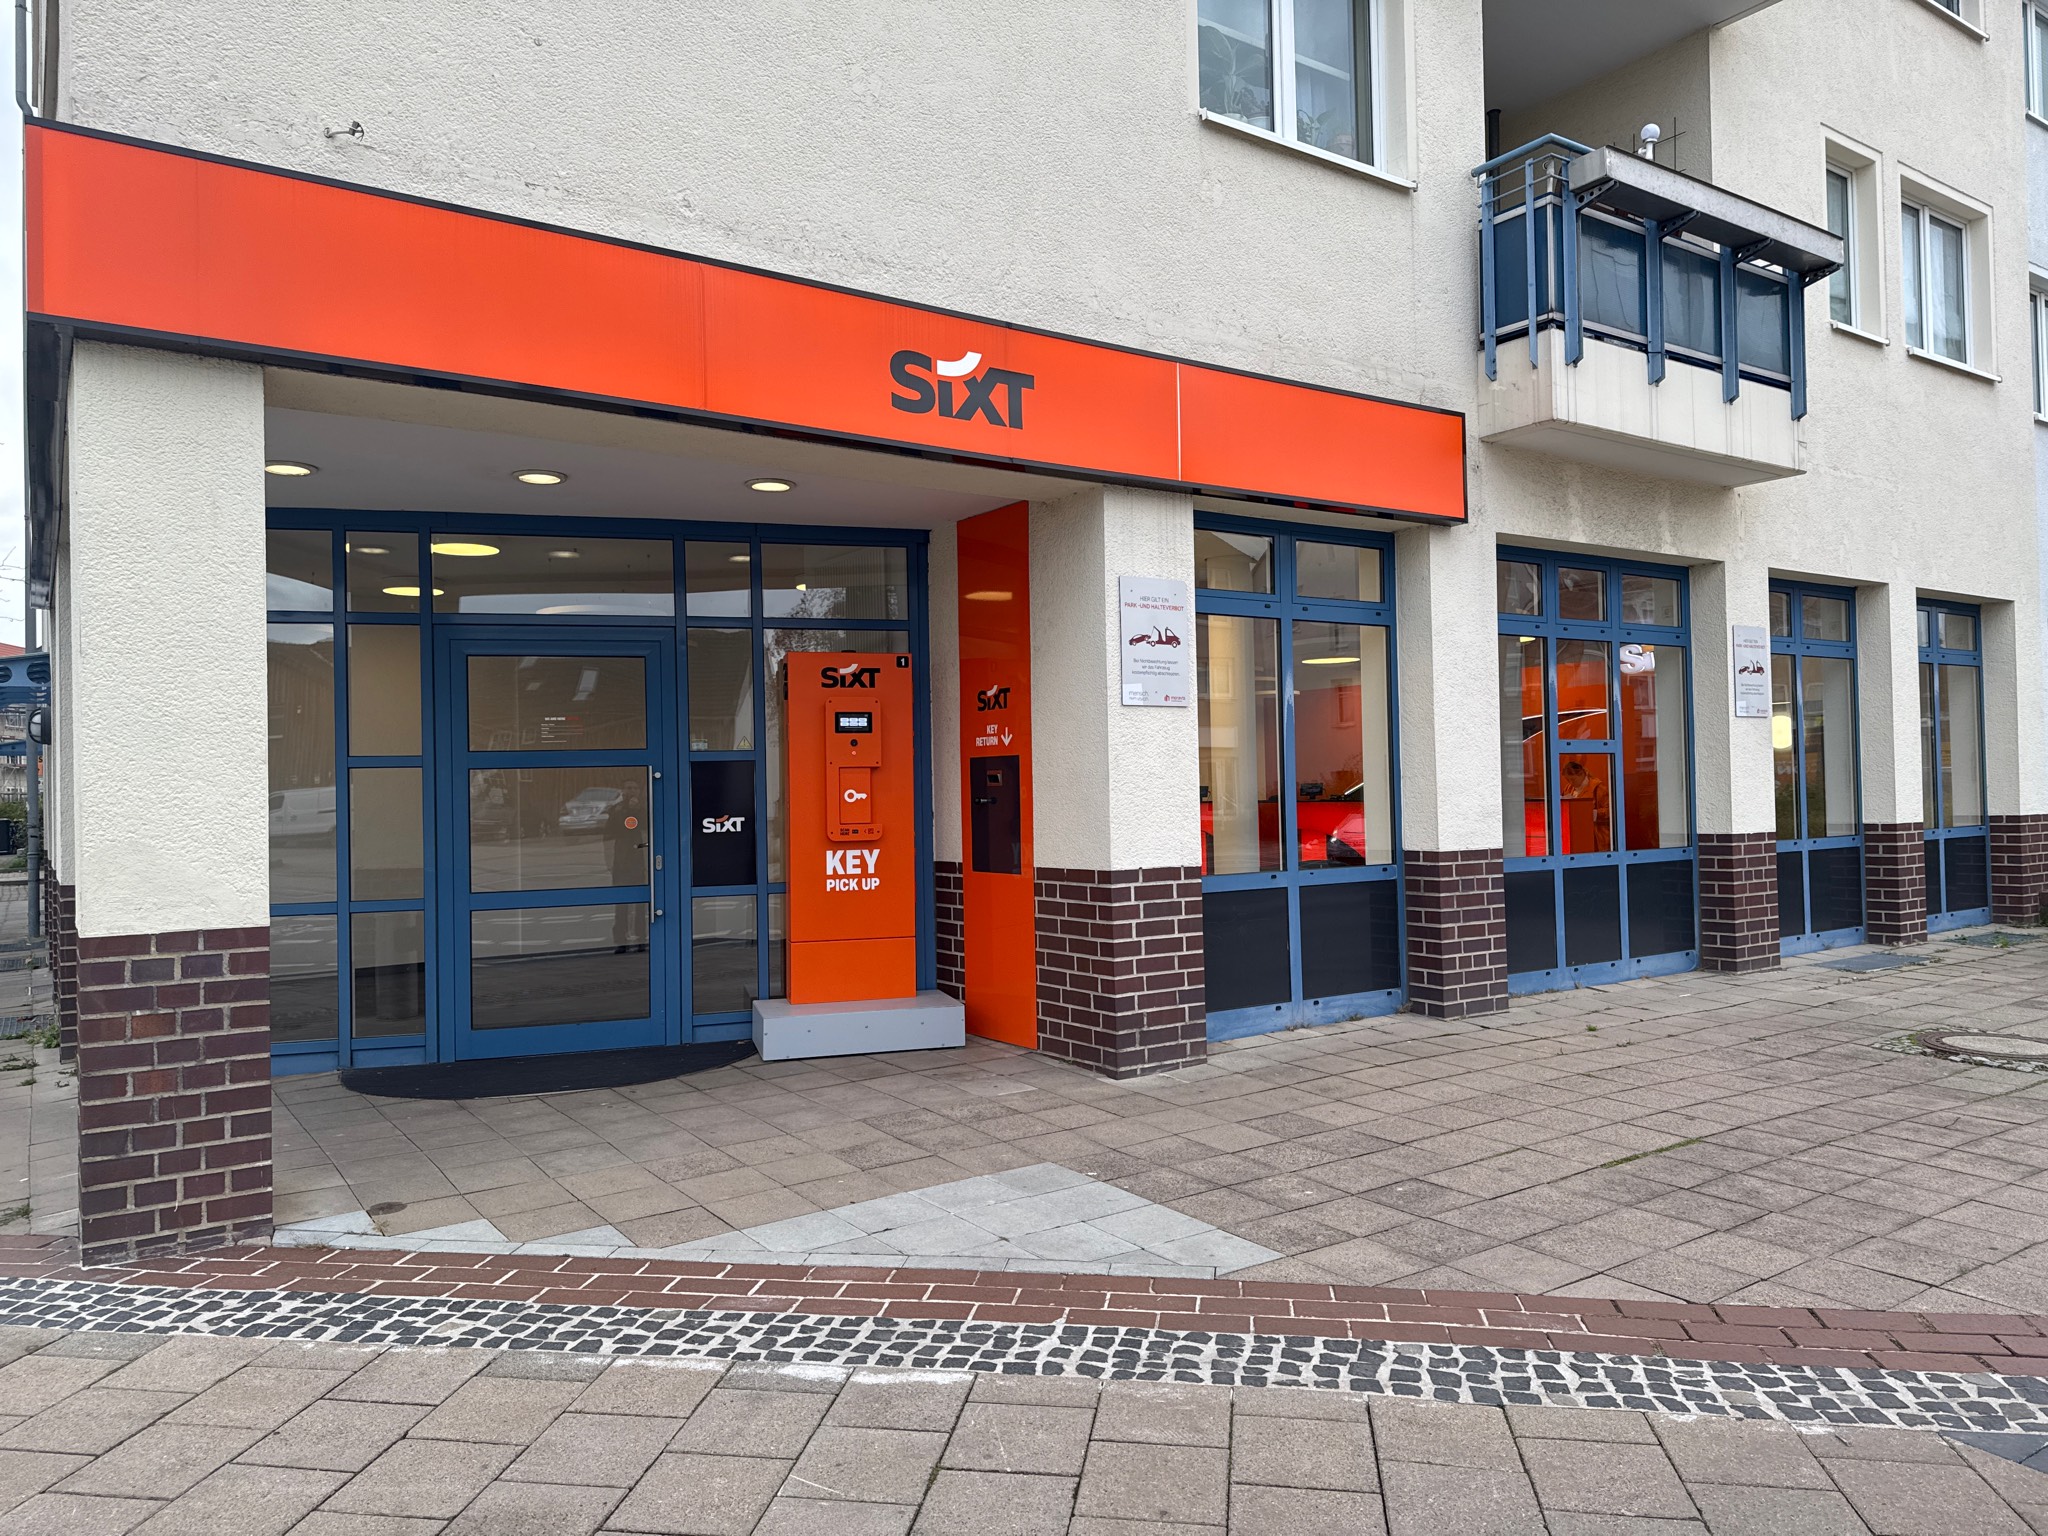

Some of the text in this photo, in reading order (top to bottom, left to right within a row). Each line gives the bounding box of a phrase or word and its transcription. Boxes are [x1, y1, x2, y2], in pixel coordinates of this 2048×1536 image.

[1150, 604, 1184, 612] HALTEVERBOT
[900, 657, 906, 666] 1
[986, 724, 998, 734] KEY
[975, 736, 998, 747] RETURN
[826, 849, 880, 876] KEY
[826, 877, 880, 892] PICK UP
